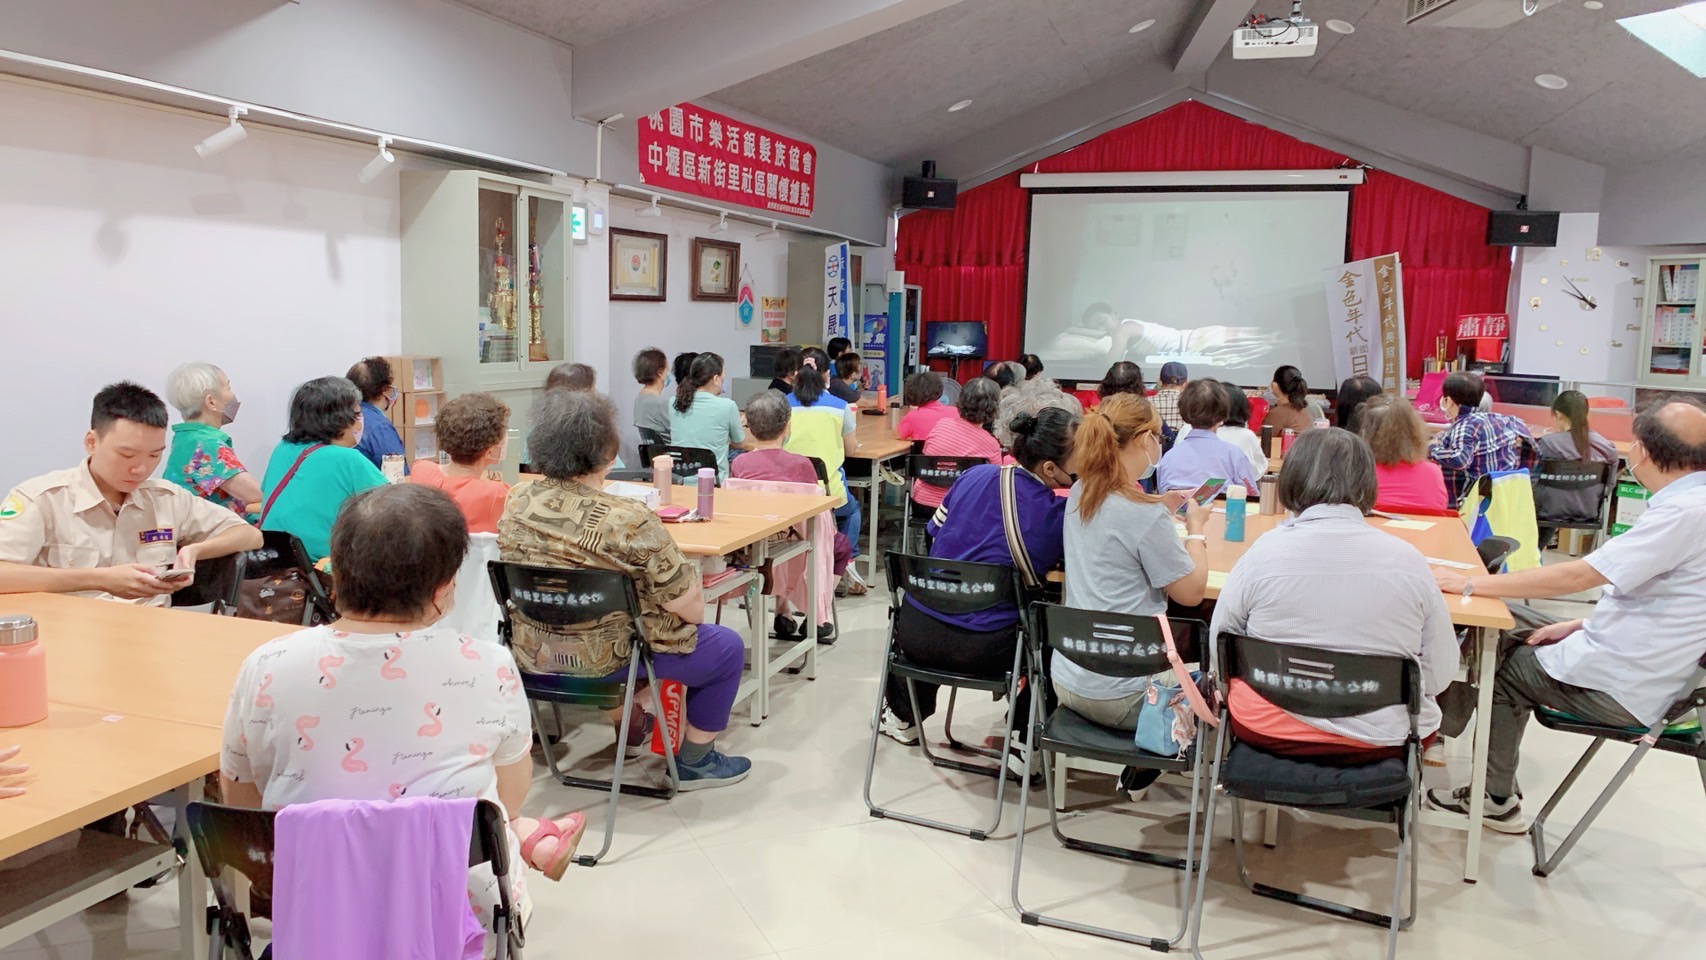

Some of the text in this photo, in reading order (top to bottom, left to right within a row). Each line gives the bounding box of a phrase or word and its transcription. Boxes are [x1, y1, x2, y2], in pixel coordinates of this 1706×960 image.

[648, 106, 812, 175] 桃園市樂活銀髮族協會
[648, 141, 810, 207] 中壢區新街里社區關懷據點
[1338, 270, 1368, 343] 金色年代
[1457, 316, 1506, 338] 肅靜
